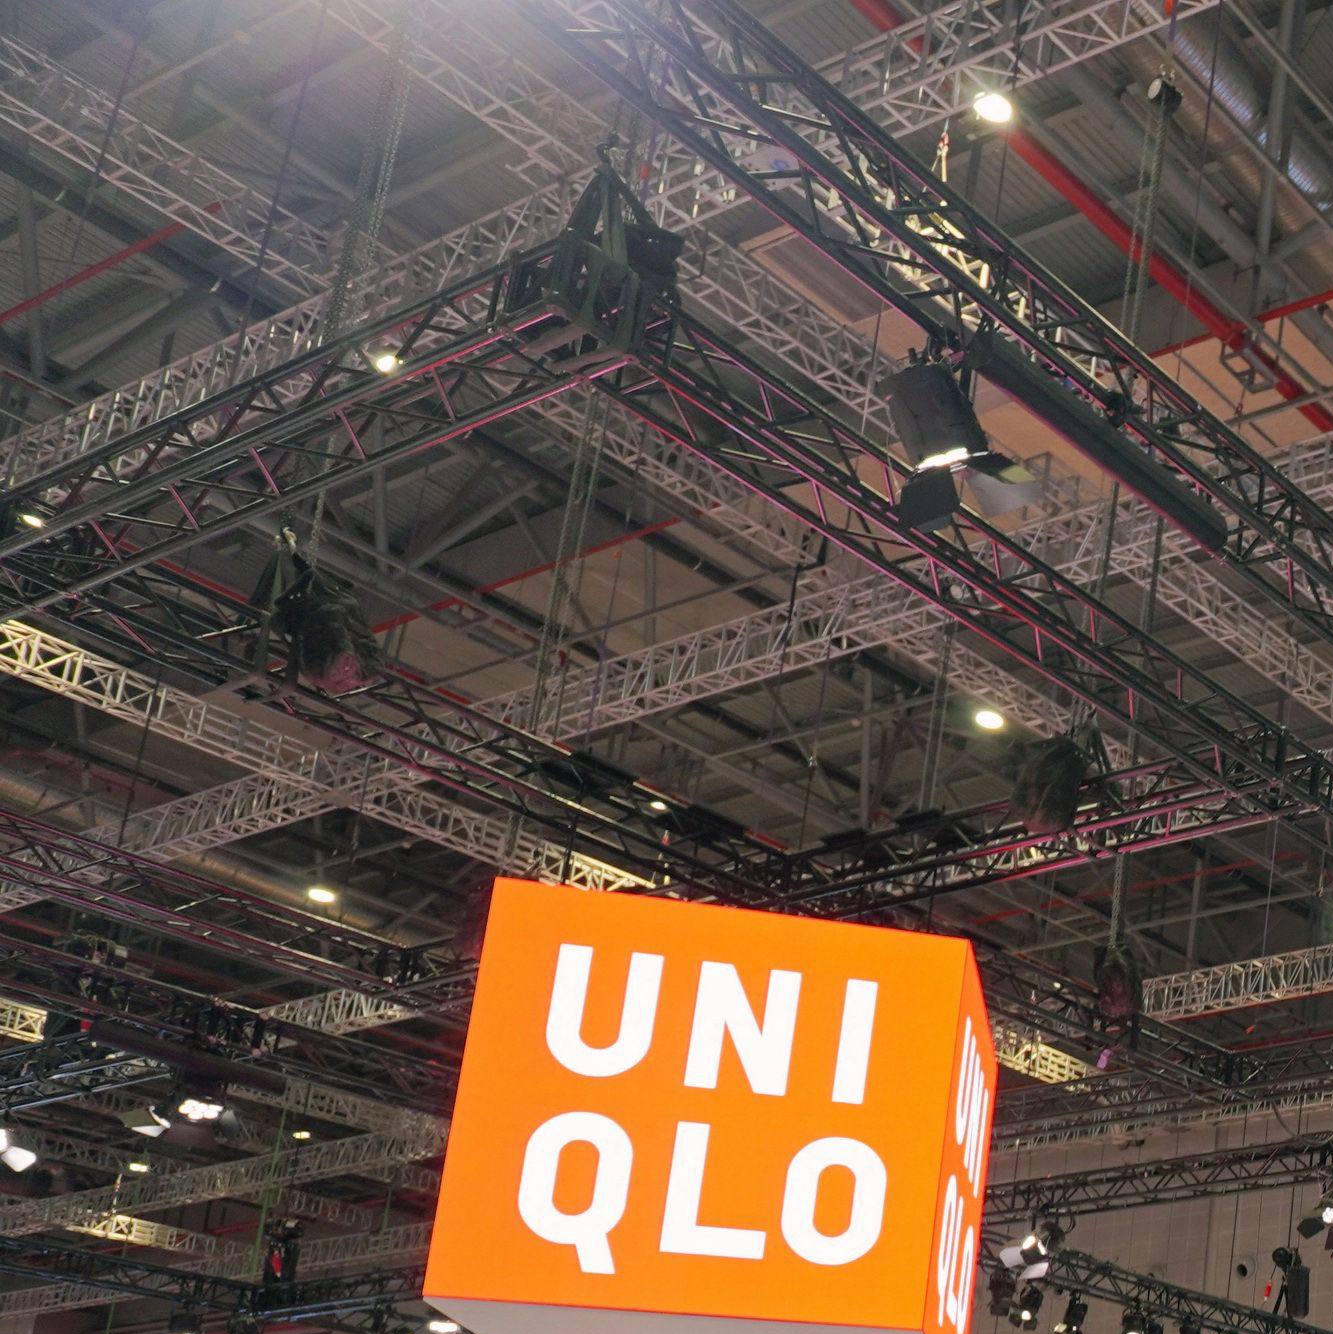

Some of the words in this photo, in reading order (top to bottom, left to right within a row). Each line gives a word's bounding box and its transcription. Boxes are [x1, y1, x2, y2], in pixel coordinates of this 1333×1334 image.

[545, 943, 879, 1105] UNI
[955, 1015, 990, 1199] UNI
[517, 1111, 887, 1275] QLO
